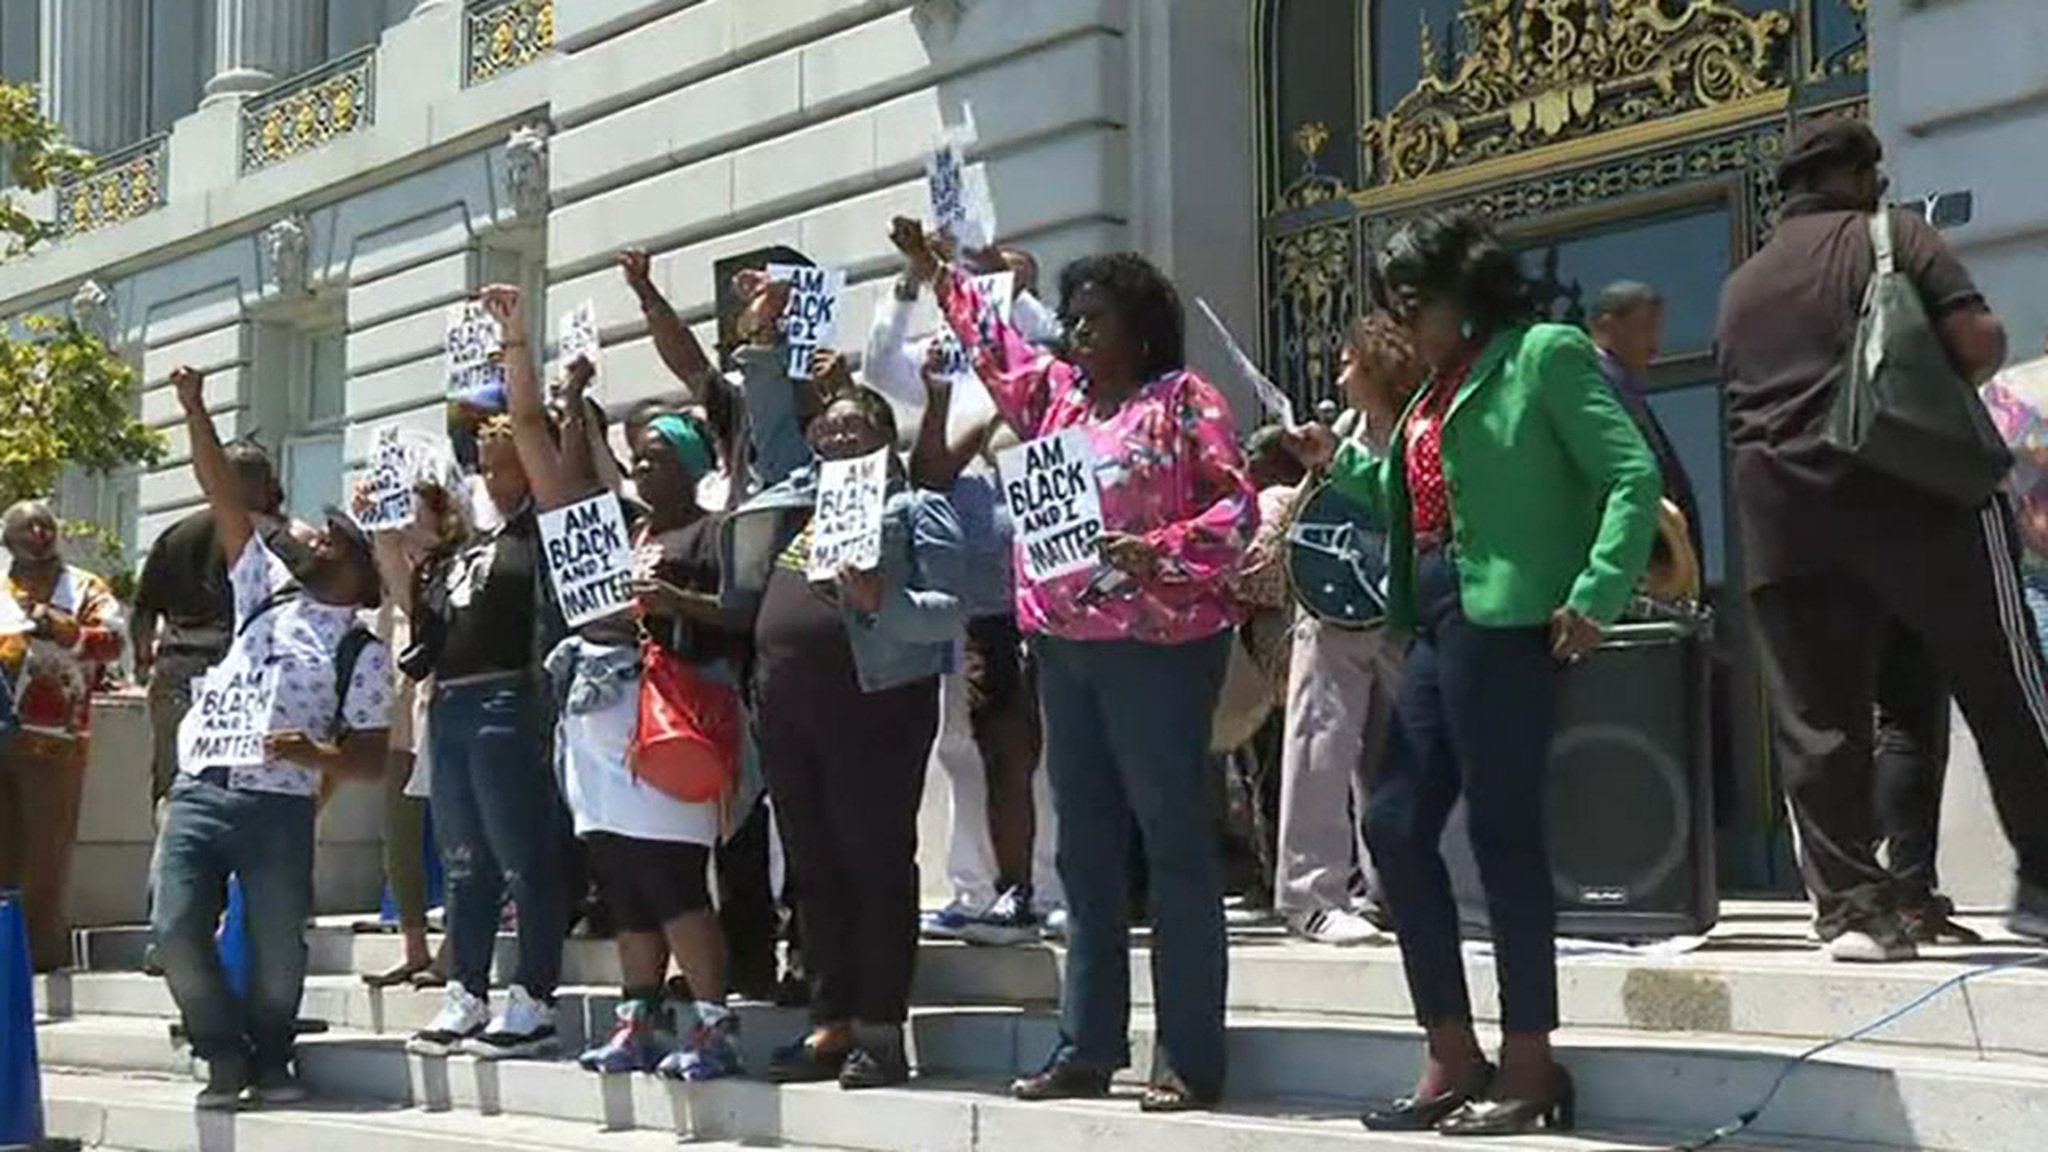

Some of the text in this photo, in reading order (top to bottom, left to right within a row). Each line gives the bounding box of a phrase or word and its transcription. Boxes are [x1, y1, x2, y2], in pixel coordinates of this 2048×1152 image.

[789, 268, 824, 293] AM
[789, 294, 835, 322] ACK
[843, 460, 877, 487] AM
[1025, 436, 1065, 477] AM
[820, 483, 880, 520] BLACK
[1007, 461, 1087, 517] BLACK
[564, 501, 602, 536] AM
[1023, 499, 1080, 535] AND I
[548, 520, 621, 571] BLACK
[1028, 517, 1100, 576] MATTER
[561, 553, 615, 584] AND I
[563, 569, 633, 621] MATTER
[225, 670, 264, 691] AM
[202, 689, 272, 717] BLACK
